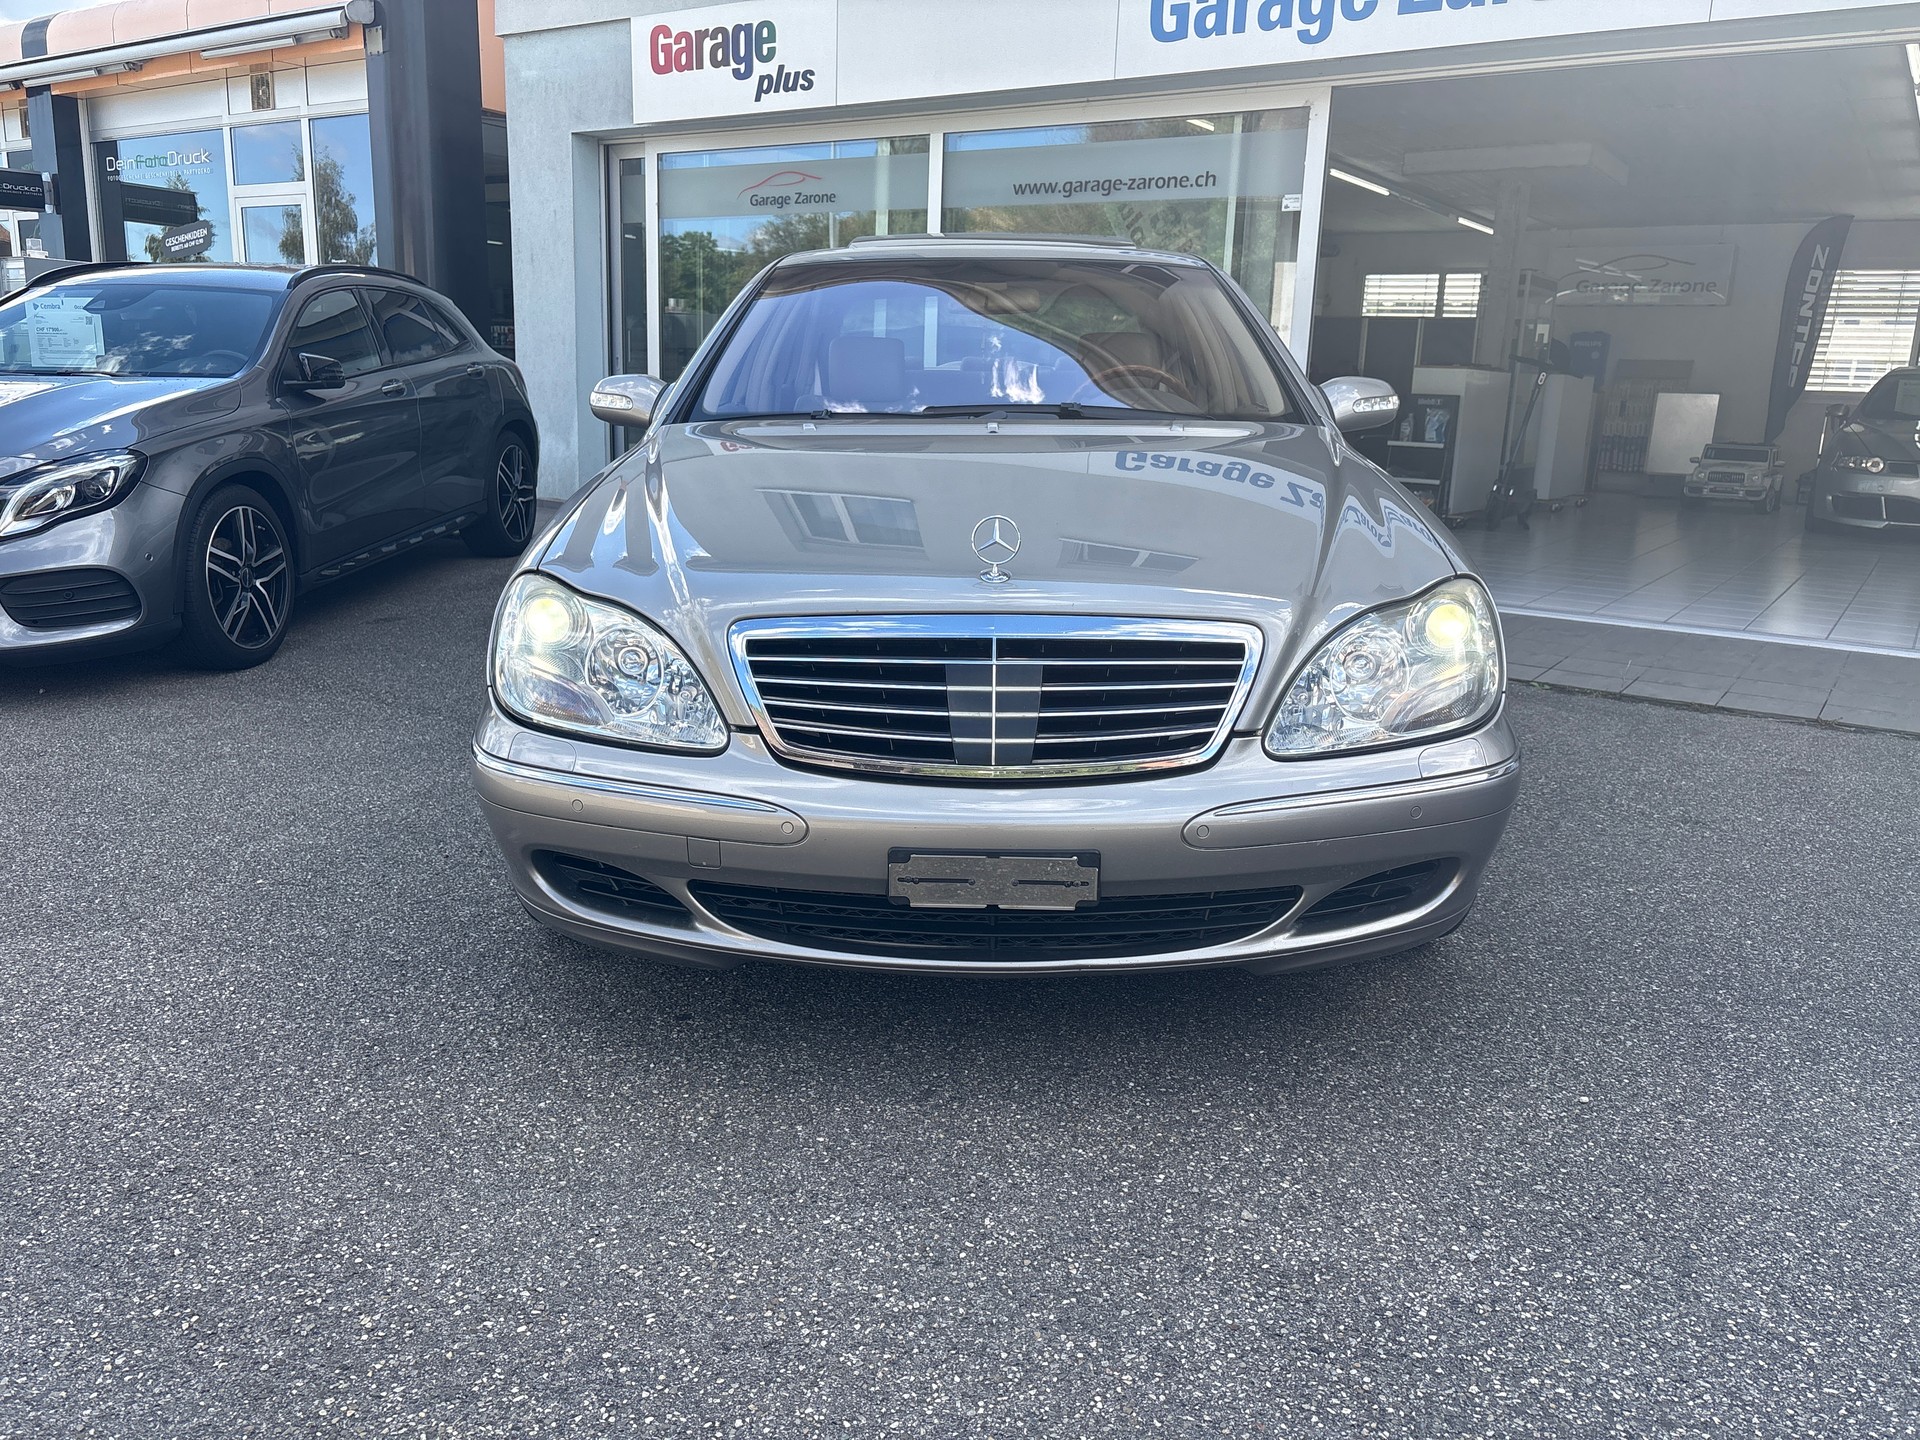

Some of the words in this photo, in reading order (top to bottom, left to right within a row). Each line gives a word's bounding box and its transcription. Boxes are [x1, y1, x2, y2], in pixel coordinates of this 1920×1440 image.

[649, 19, 777, 81] Garage
[754, 64, 816, 103] plus
[1013, 170, 1217, 198] www.garage-zarone.ch
[750, 194, 791, 209] Garage
[794, 192, 837, 205] Zarone
[165, 227, 208, 247] GESCHENKIDEEN
[1648, 279, 1717, 293] Zarone
[40, 302, 62, 310] Cembra
